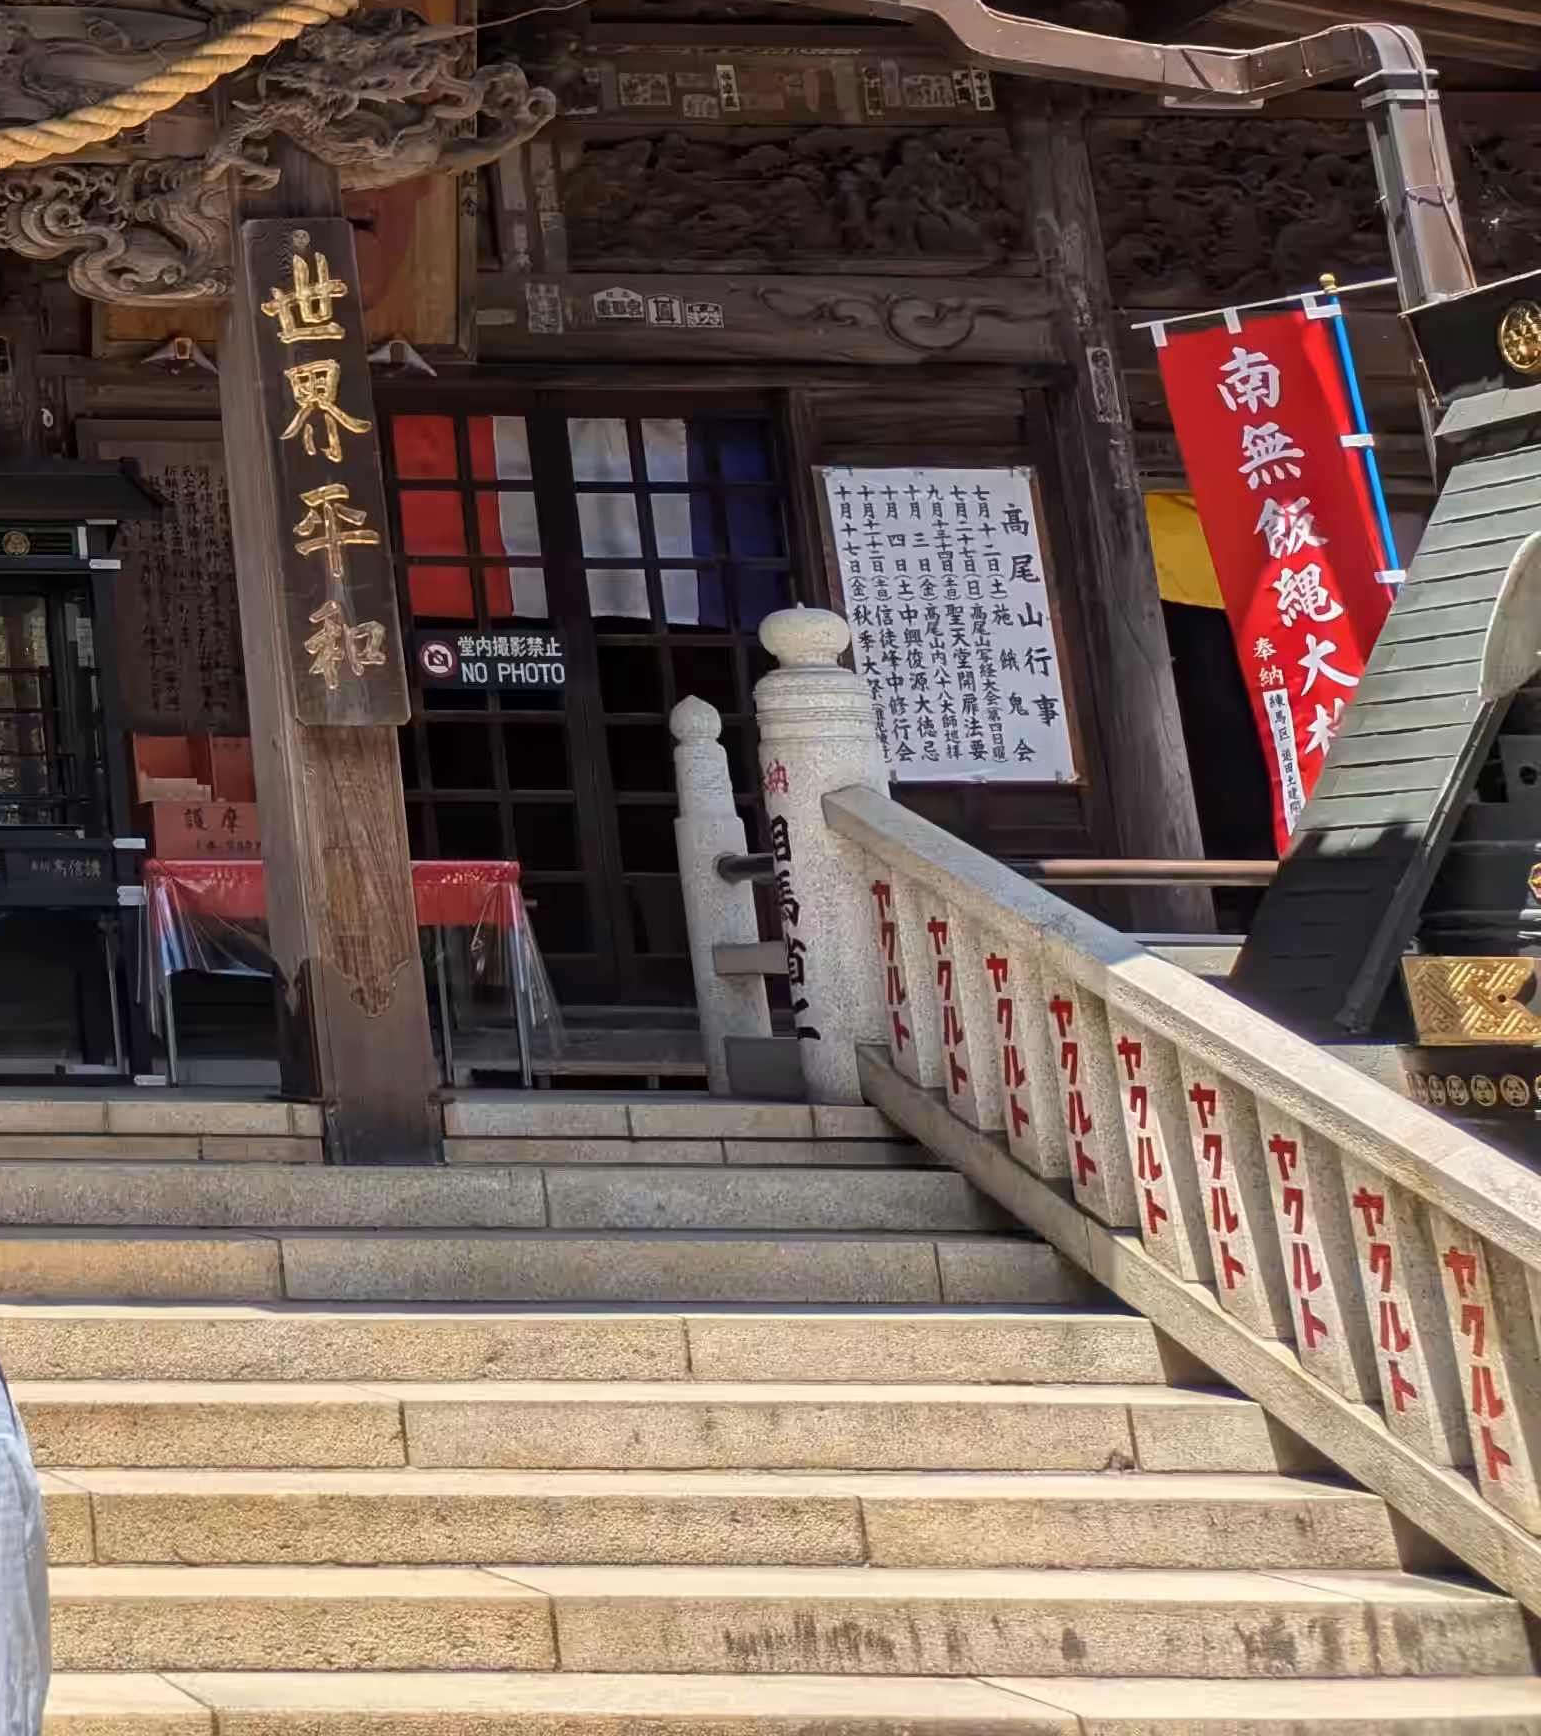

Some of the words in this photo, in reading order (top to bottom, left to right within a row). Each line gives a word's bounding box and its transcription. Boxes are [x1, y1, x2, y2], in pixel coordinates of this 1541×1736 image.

[260, 251, 387, 690] 世界平和
[457, 635, 563, 658] 堂内撮影禁止
[461, 662, 487, 684] NO
[498, 661, 566, 684] PHOTO
[1000, 502, 1060, 727] 高尾山行事
[1252, 636, 1285, 688] 奉納
[871, 880, 911, 1051] ヤクルト
[927, 917, 968, 1095] ヤクルト
[985, 953, 1031, 1138] ヤクルト
[1049, 995, 1097, 1187] ヤクルト
[1117, 1036, 1168, 1234] ヤクルト
[1190, 1083, 1246, 1292] ヤクルト
[1268, 1133, 1329, 1350] ヤクルト
[1352, 1186, 1416, 1413] ヤクルト
[1444, 1246, 1512, 1482] ヤクルト
